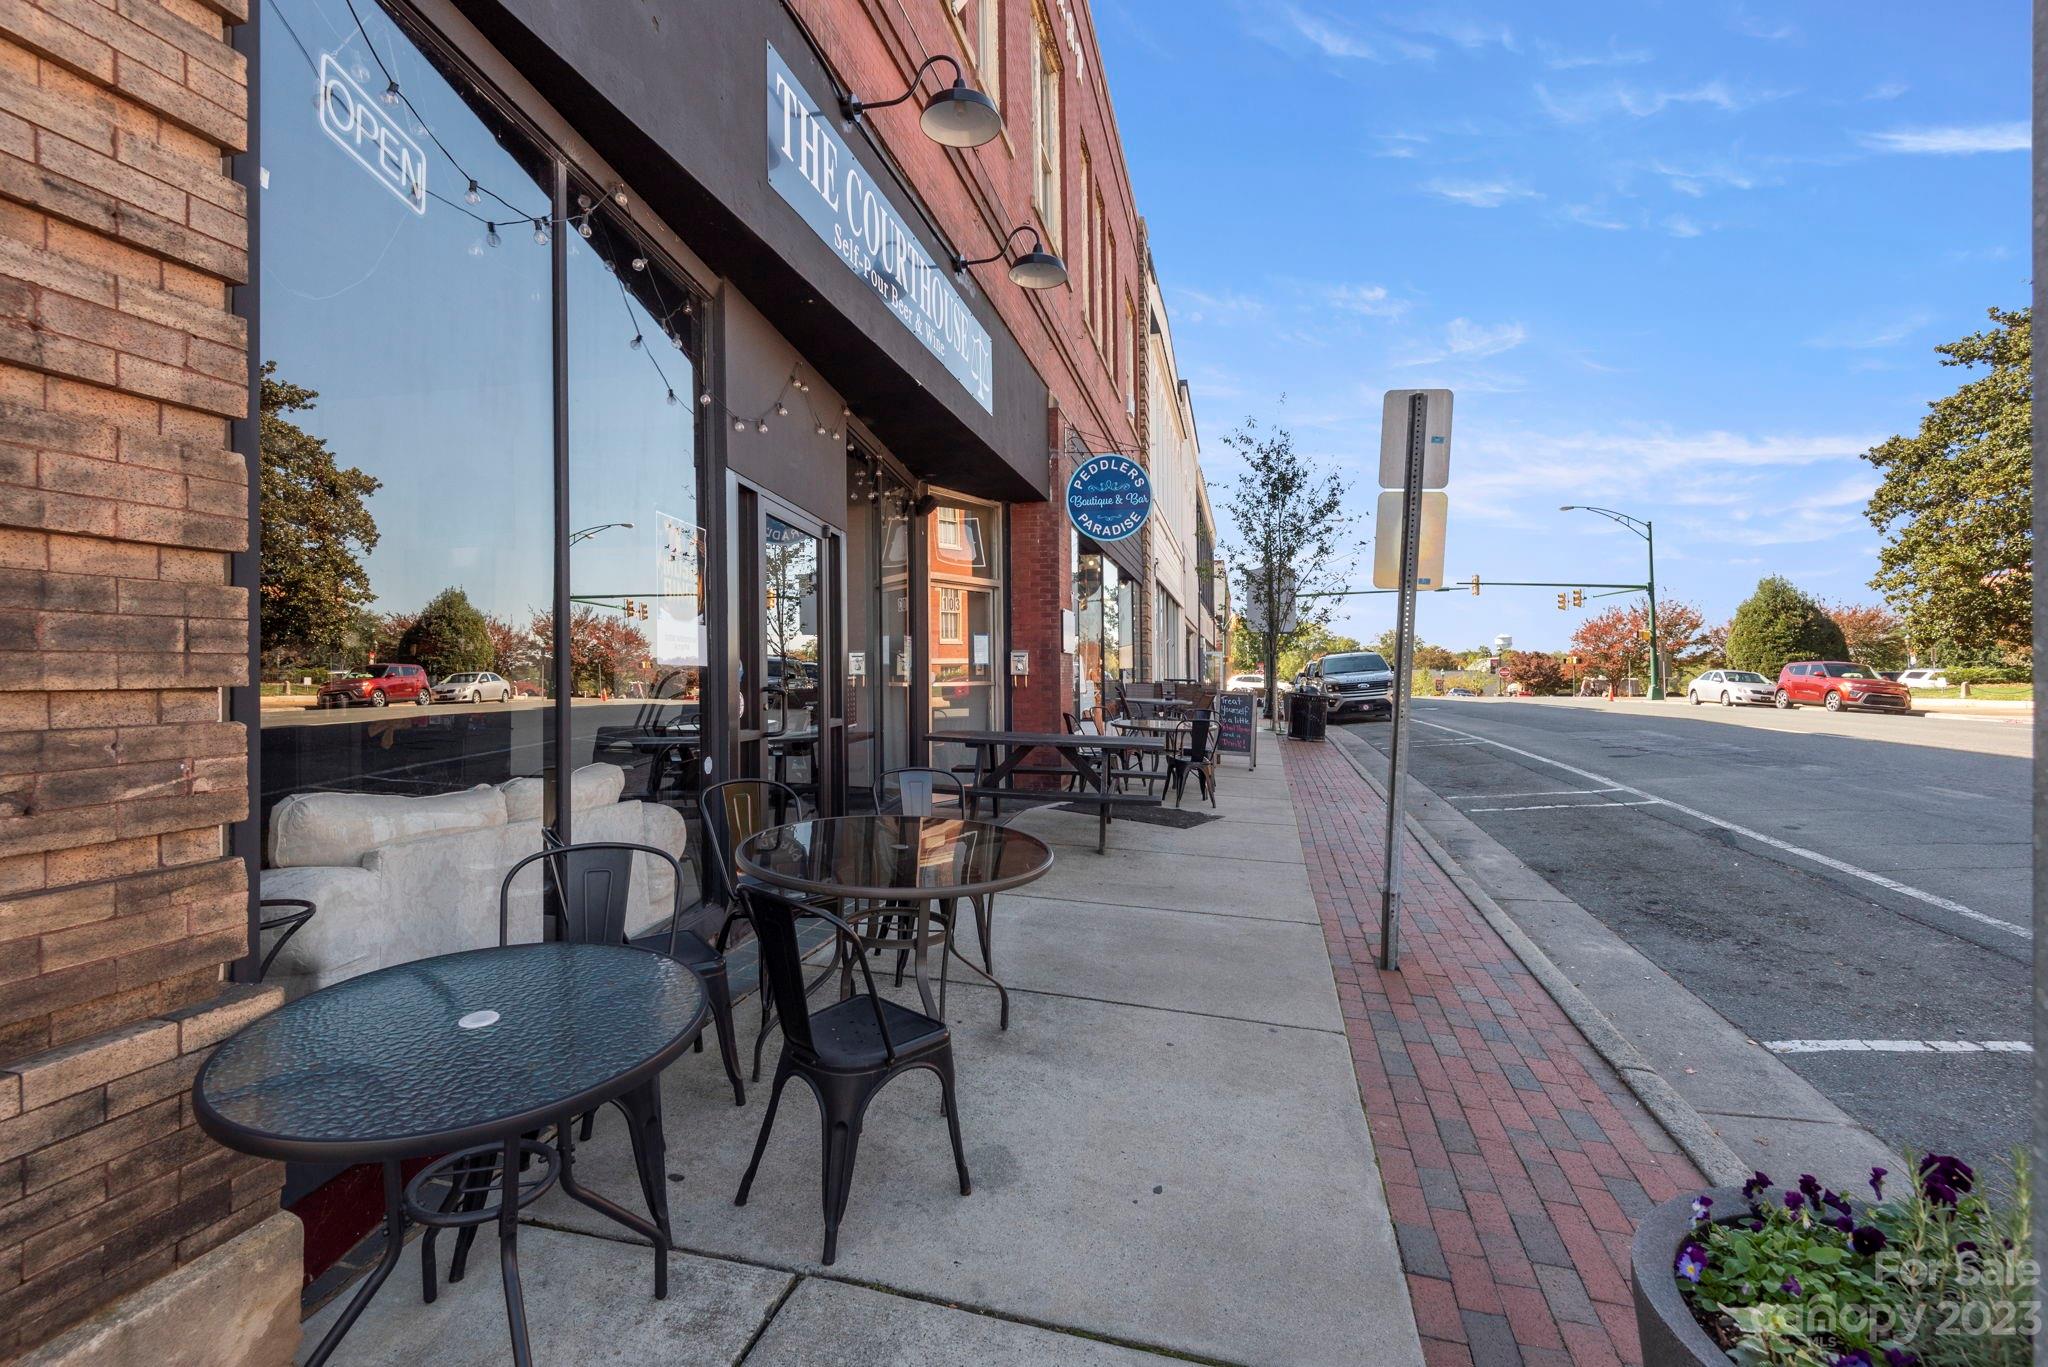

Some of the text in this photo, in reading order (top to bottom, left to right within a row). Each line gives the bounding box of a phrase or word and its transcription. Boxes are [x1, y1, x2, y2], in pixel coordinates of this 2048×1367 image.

[326, 79, 422, 200] OPEN
[776, 72, 969, 362] THE COURTHOUSE
[834, 223, 946, 356] Self-Pour Beer & Wine
[1073, 459, 1145, 490] PEDDLERS
[1069, 492, 1149, 508] Boutique & Bar
[1078, 511, 1142, 536] PARADISE
[942, 597, 961, 612] 103
[1221, 696, 1241, 705] Treat
